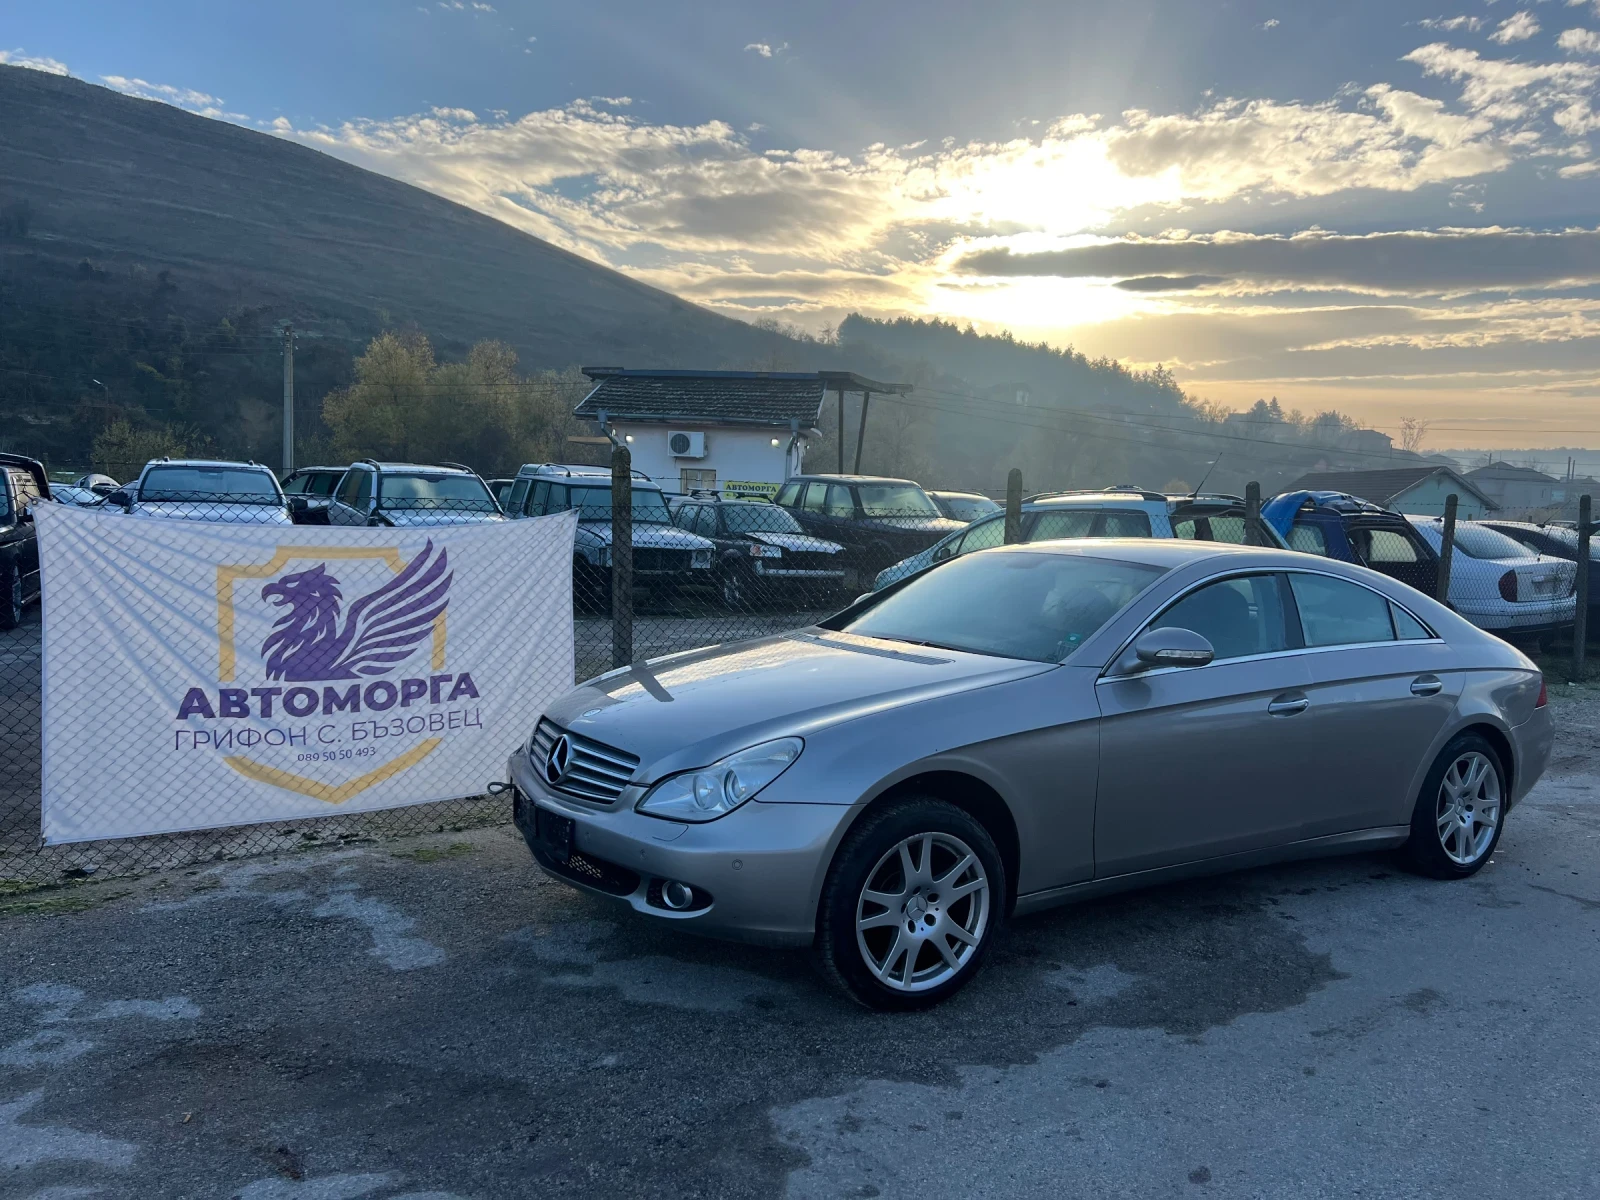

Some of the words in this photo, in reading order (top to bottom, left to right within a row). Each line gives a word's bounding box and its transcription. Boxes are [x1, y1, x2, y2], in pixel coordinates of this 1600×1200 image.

[726, 484, 776, 492] АВТОМОРГА
[176, 672, 480, 720] АВТОМОРГА
[175, 727, 307, 750] ГРИФОН
[317, 724, 342, 744] С.
[352, 707, 483, 741] БЪЗОВЕЦ
[297, 752, 320, 762] 089
[322, 751, 336, 762] 50
[339, 749, 353, 760] 50
[355, 746, 377, 757] 493
